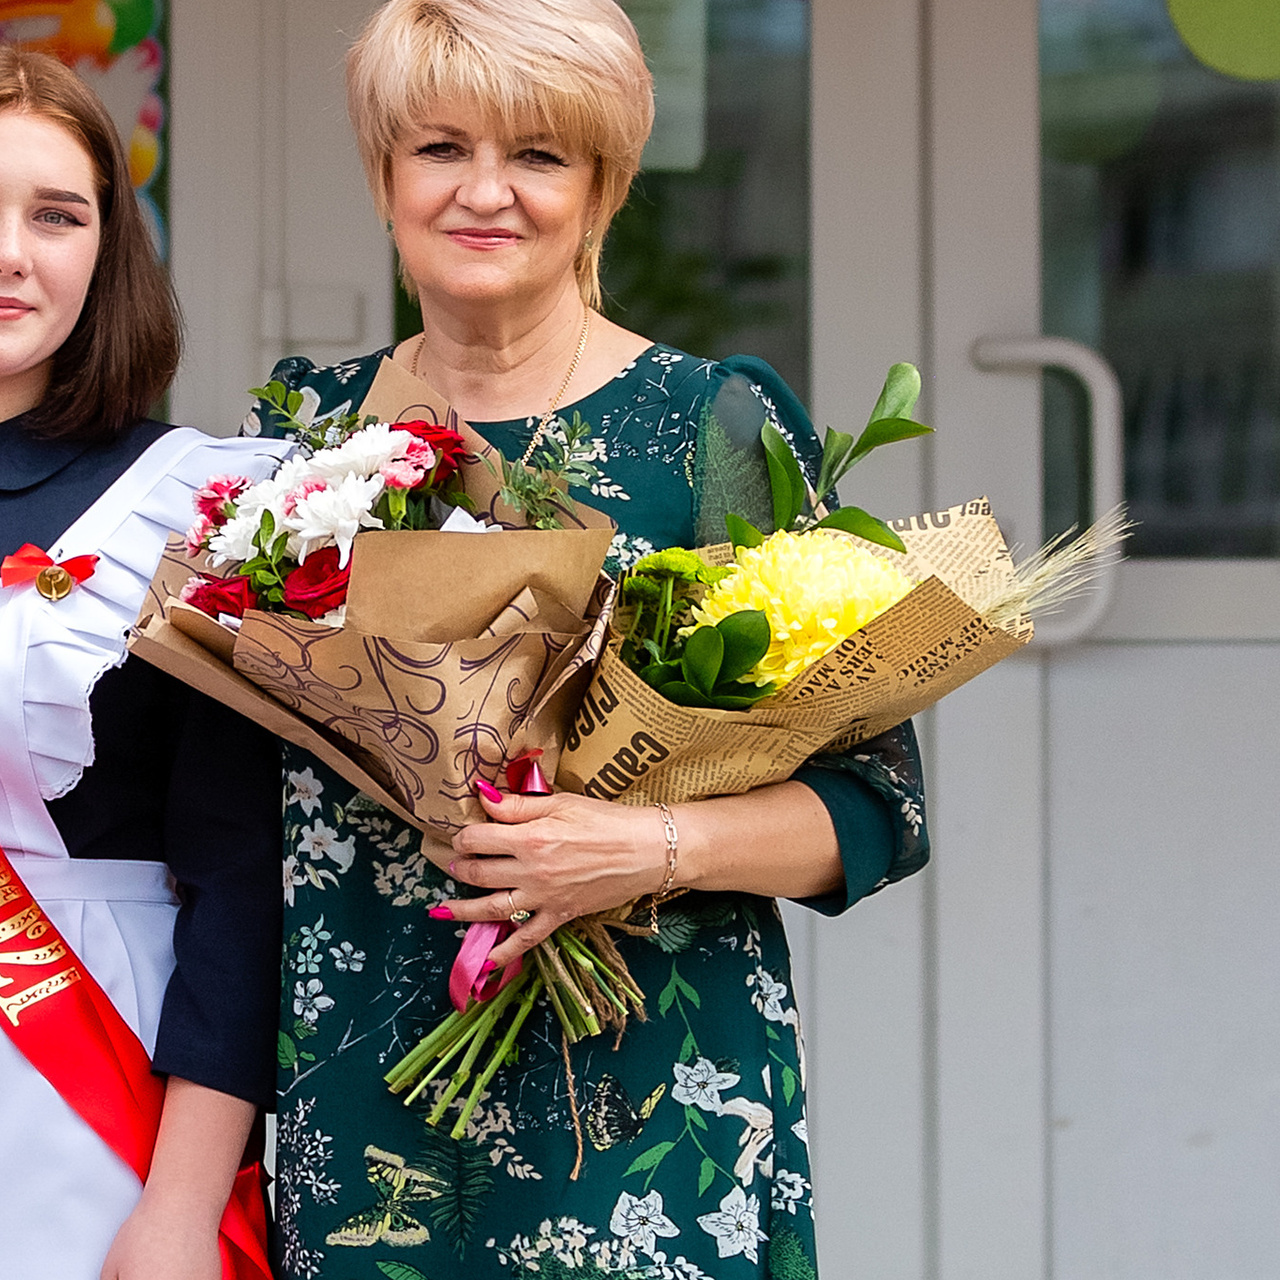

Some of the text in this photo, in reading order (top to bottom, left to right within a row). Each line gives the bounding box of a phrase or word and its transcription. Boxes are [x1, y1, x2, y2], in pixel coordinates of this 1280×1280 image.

[954, 620, 995, 651] ERS
[895, 636, 955, 681] MAGIC
[793, 661, 836, 707] MAG
